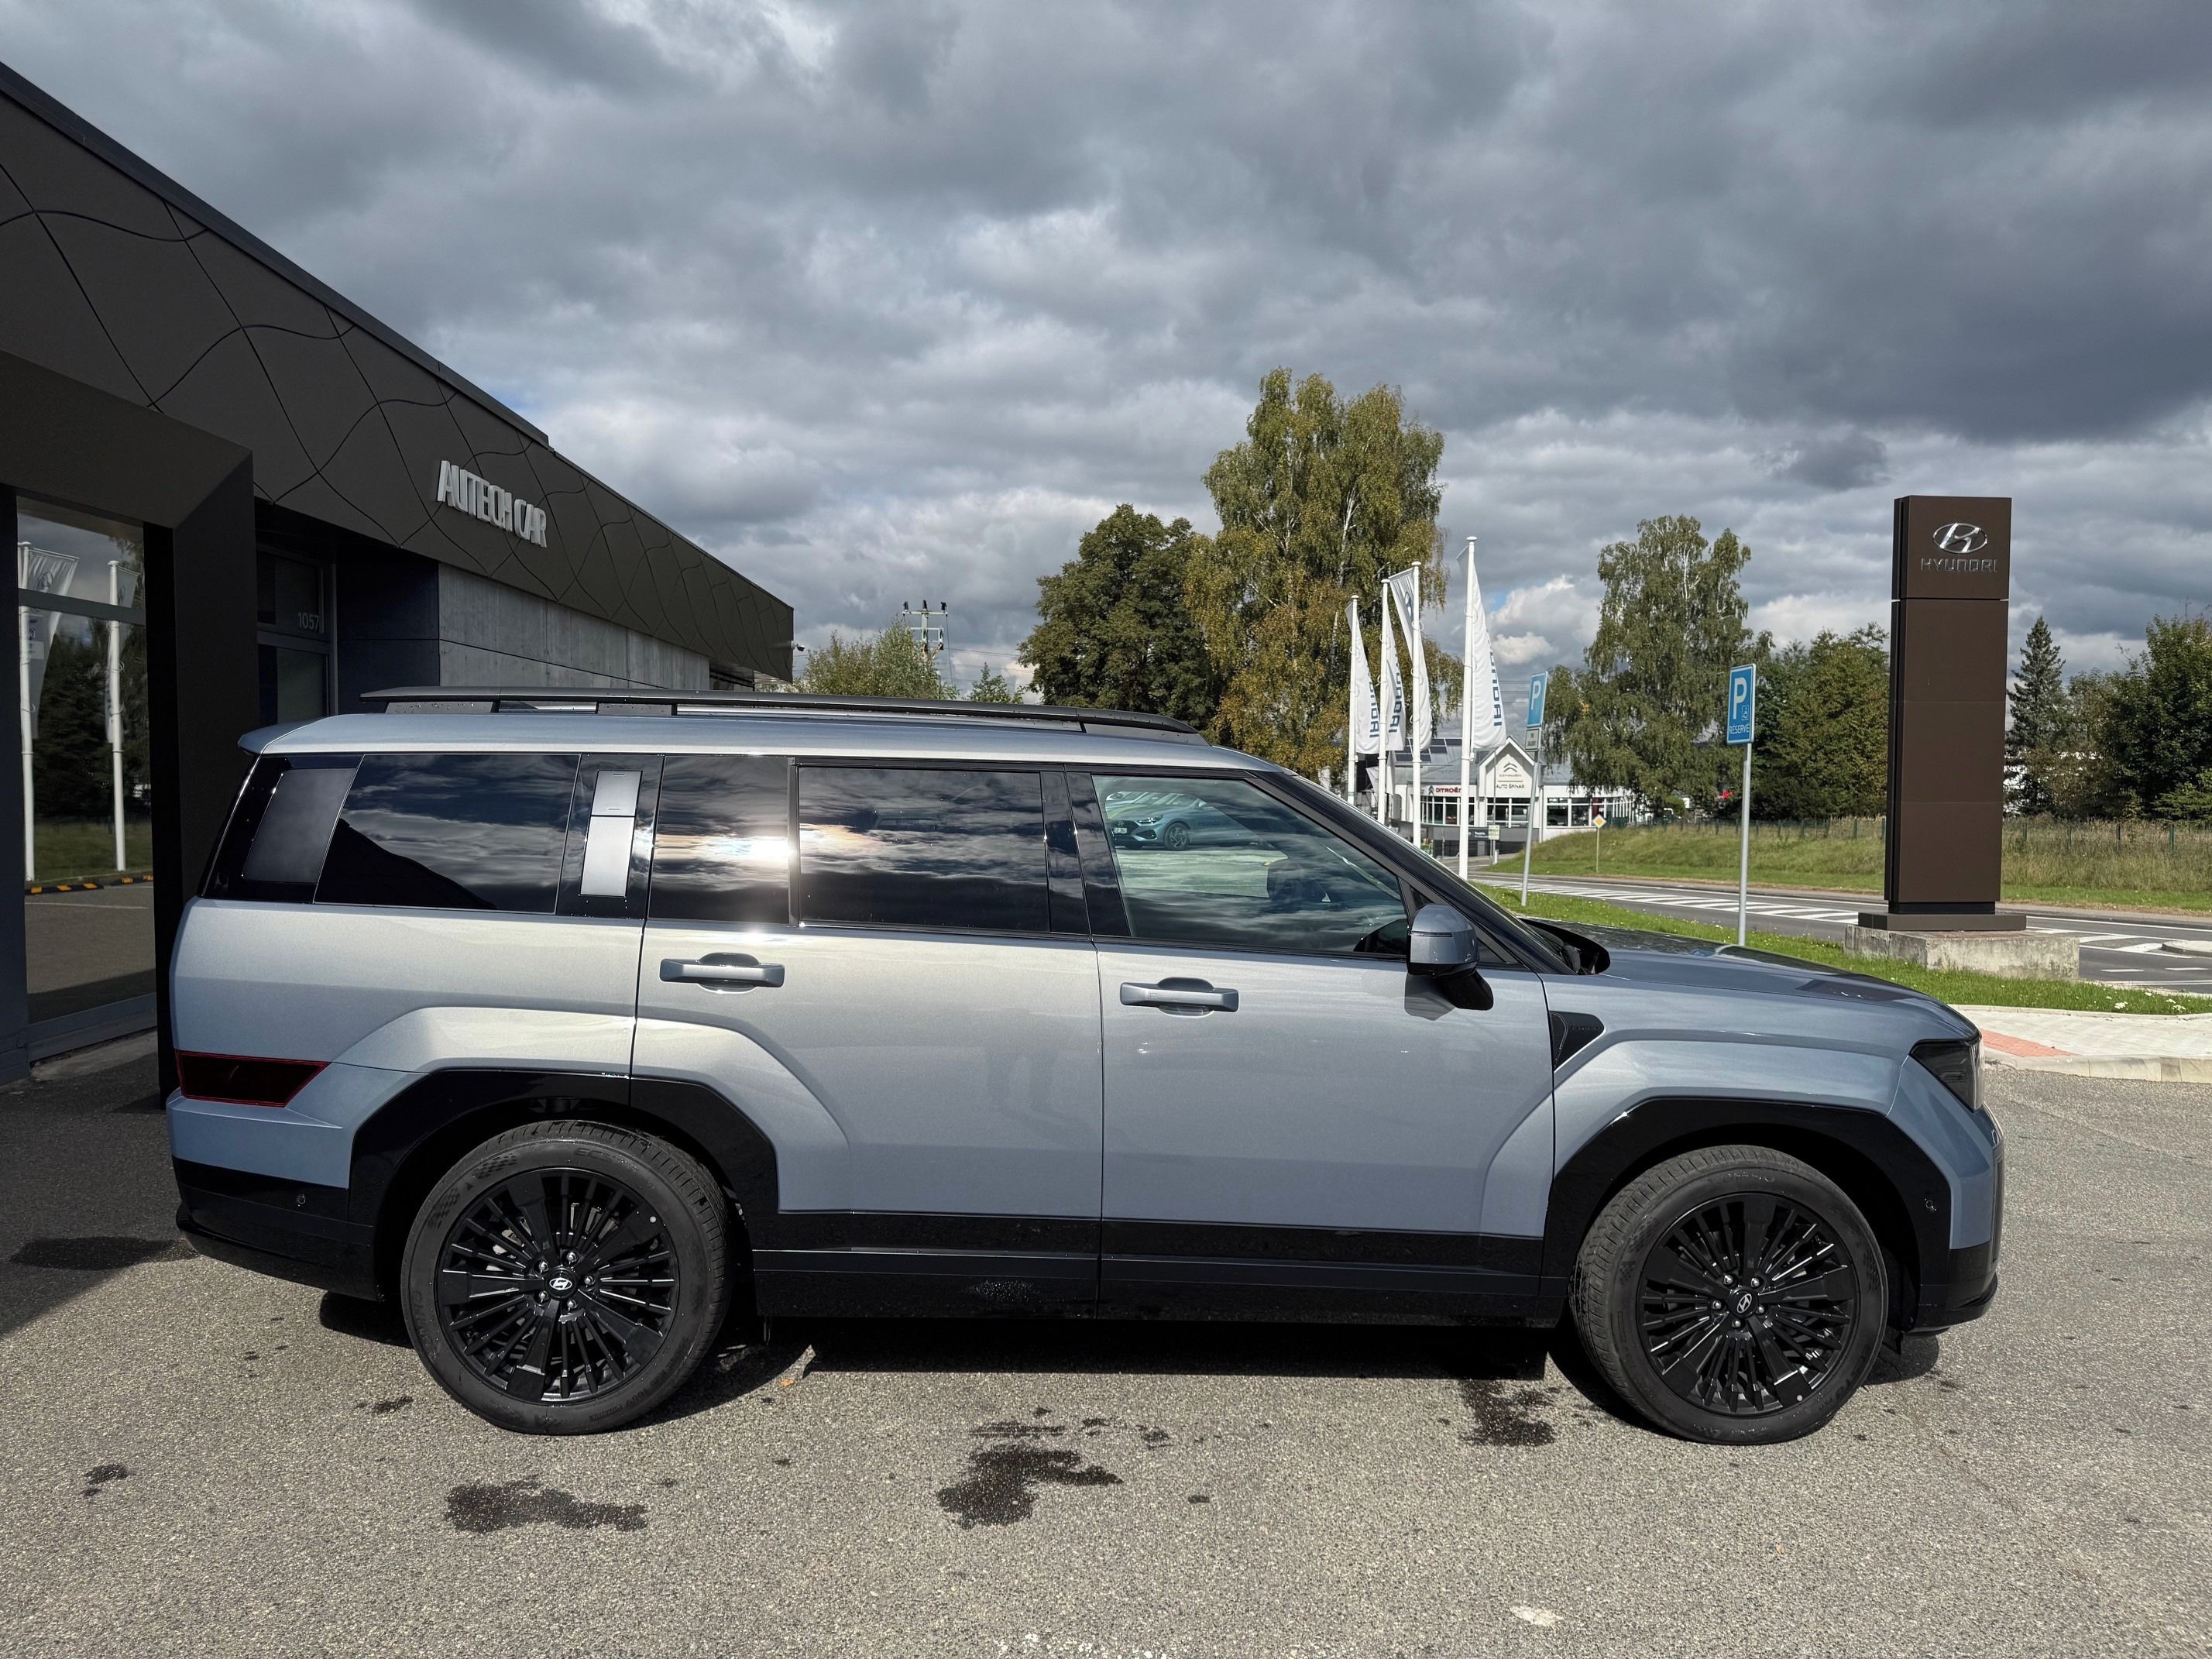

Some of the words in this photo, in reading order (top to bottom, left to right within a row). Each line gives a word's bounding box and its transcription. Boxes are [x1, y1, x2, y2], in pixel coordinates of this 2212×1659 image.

[437, 460, 513, 532] AUTECH
[514, 499, 548, 548] CAR
[1921, 558, 1997, 572] HYUNDAI
[297, 612, 318, 630] 1057
[1530, 680, 1541, 710] P
[1733, 677, 1747, 719] P
